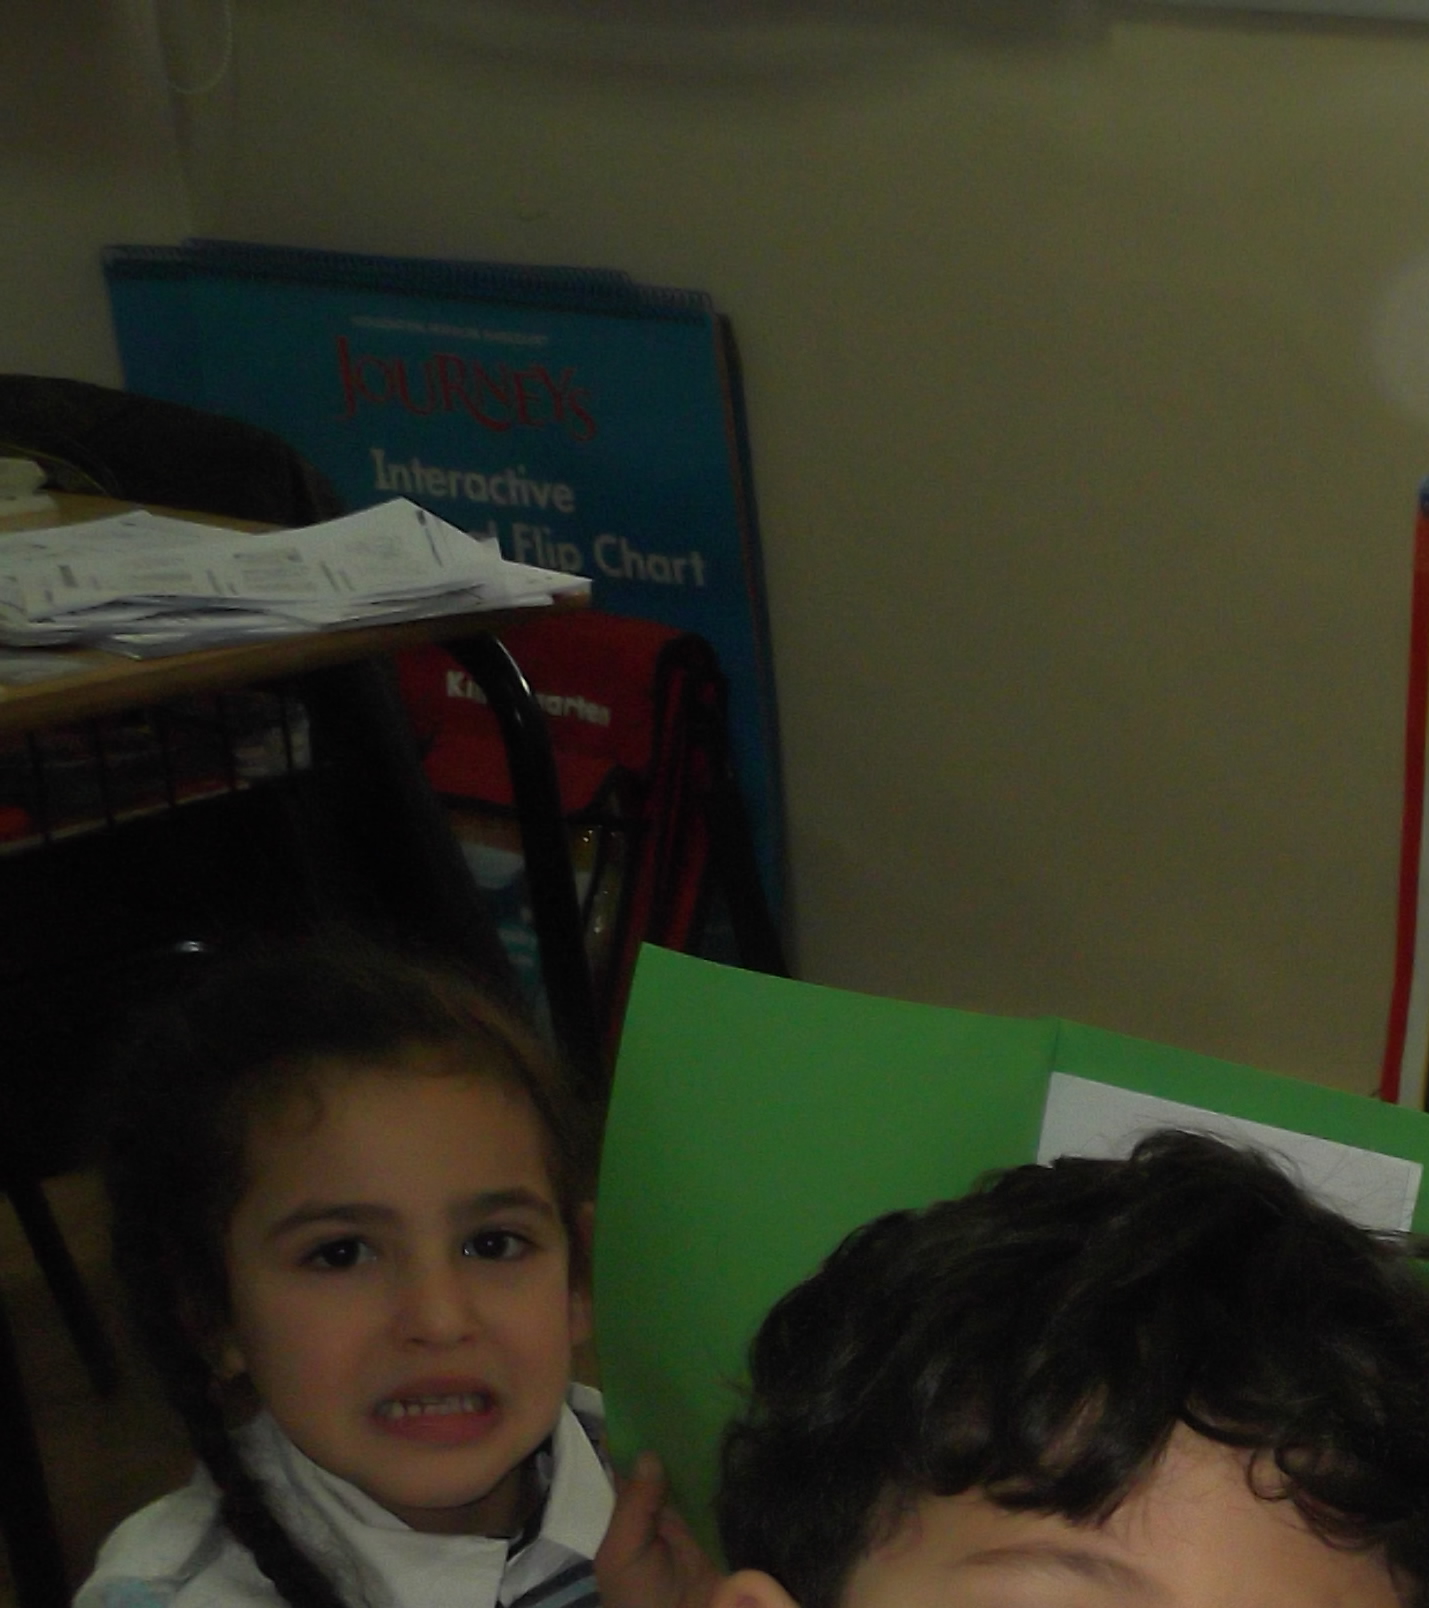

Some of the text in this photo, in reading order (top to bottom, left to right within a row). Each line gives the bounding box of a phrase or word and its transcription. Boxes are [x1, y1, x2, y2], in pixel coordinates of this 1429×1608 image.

[333, 334, 597, 442] JOURNEYS
[369, 447, 577, 515] Interactive
[512, 520, 584, 574] Flip
[593, 531, 707, 588] Chart
